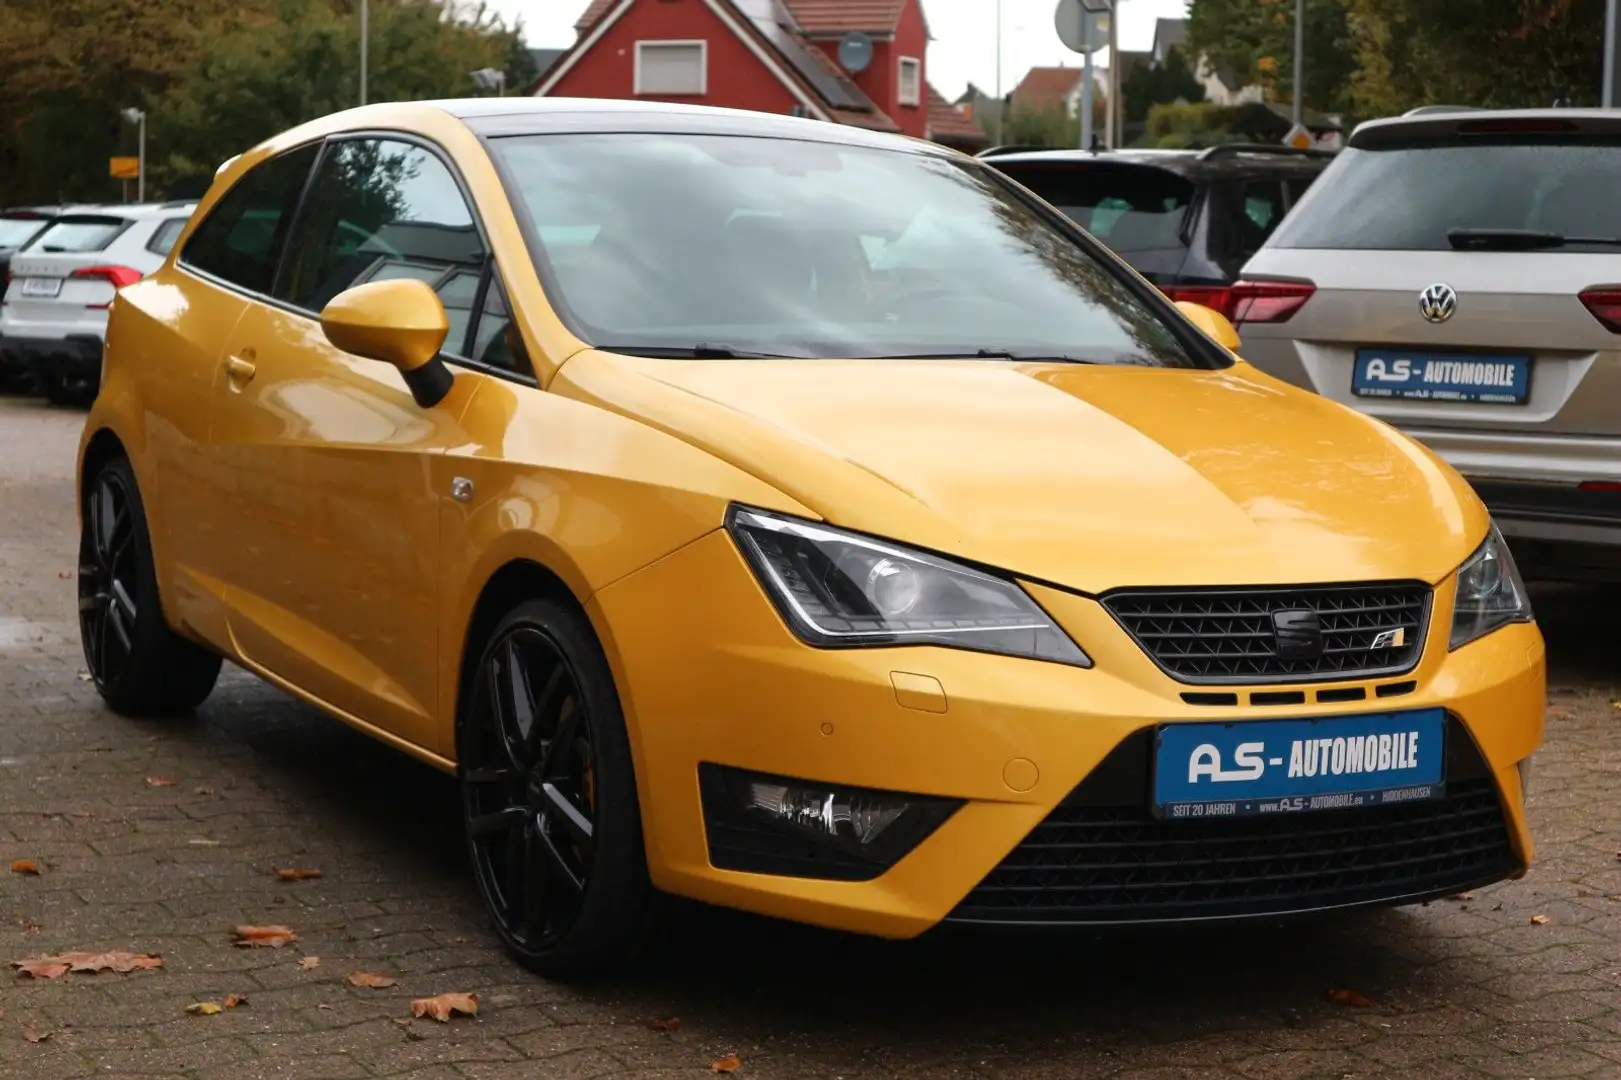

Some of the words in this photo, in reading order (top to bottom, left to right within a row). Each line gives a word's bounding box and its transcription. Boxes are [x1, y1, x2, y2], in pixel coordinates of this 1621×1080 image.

[1173, 804, 1191, 817] SEIT
[1192, 804, 1202, 816] 20
[1204, 803, 1236, 816] JAHREN
